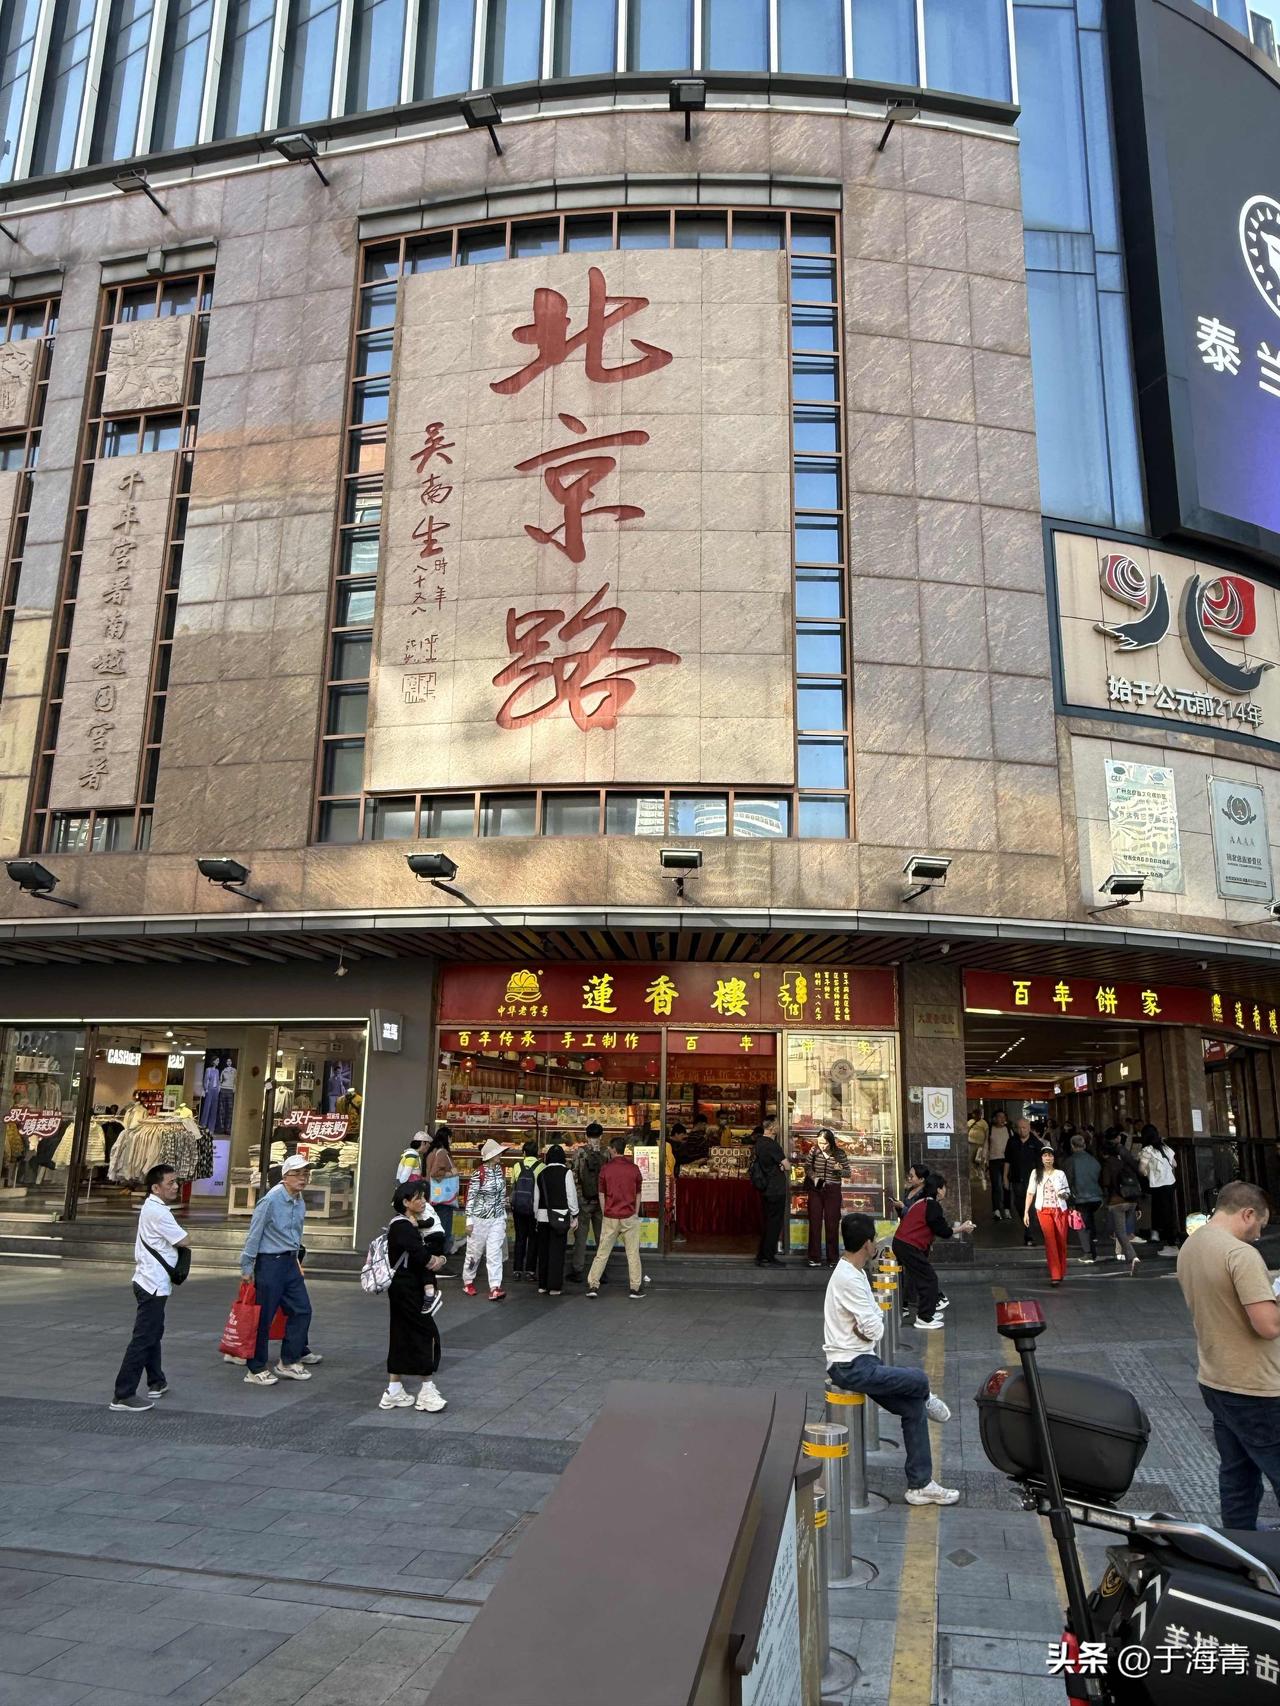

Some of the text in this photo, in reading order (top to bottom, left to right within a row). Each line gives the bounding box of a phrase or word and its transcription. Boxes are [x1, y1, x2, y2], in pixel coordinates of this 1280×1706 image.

[490, 266, 682, 732] 北京路
[1108, 675, 1264, 728] 始于公元前214年
[582, 973, 750, 1017] 蓮香樓
[458, 1030, 640, 1049] 百年传承 手工制作
[107, 1048, 142, 1066] CASHIER
[283, 1110, 323, 1125] 双十一
